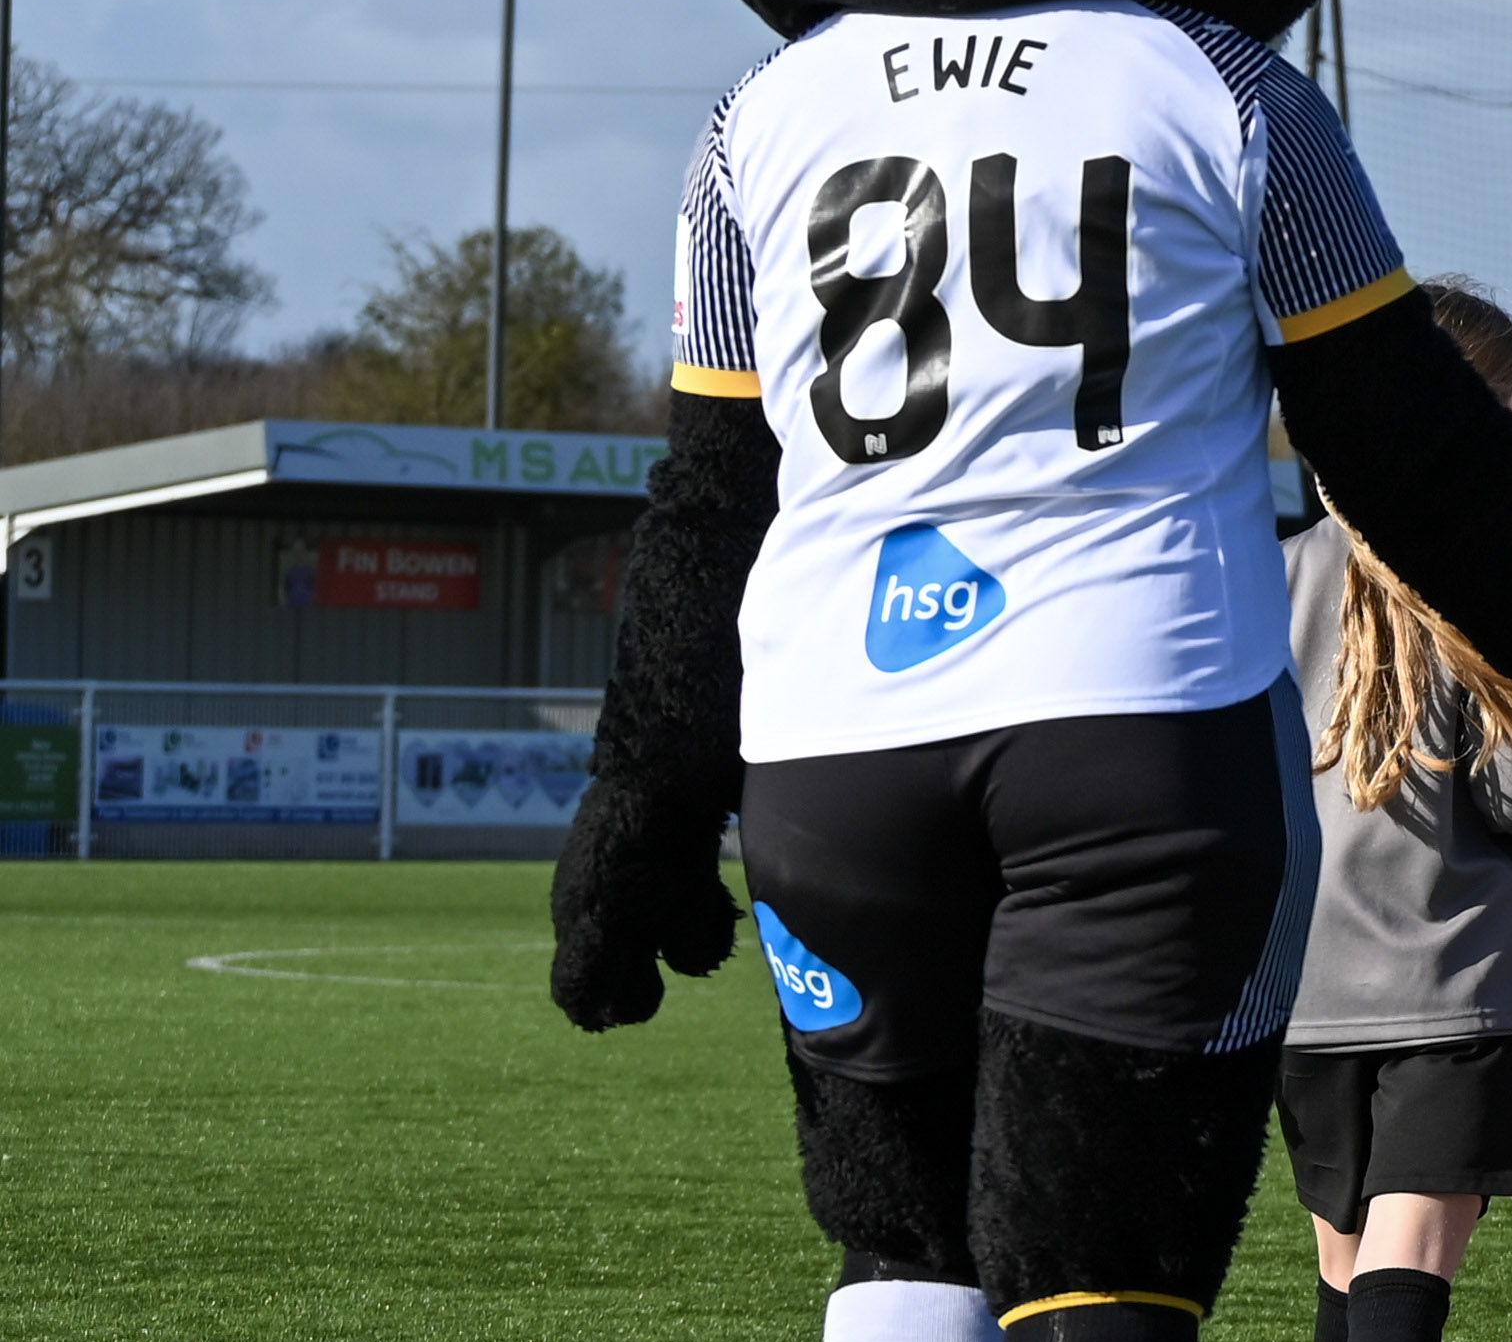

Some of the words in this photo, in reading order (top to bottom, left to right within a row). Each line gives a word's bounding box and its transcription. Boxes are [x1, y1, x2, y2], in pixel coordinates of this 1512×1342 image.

[882, 35, 1047, 102] EWIE
[807, 153, 1131, 465] 84
[24, 549, 46, 589] 3
[880, 576, 979, 632] hsg
[766, 942, 833, 1009] hsg
